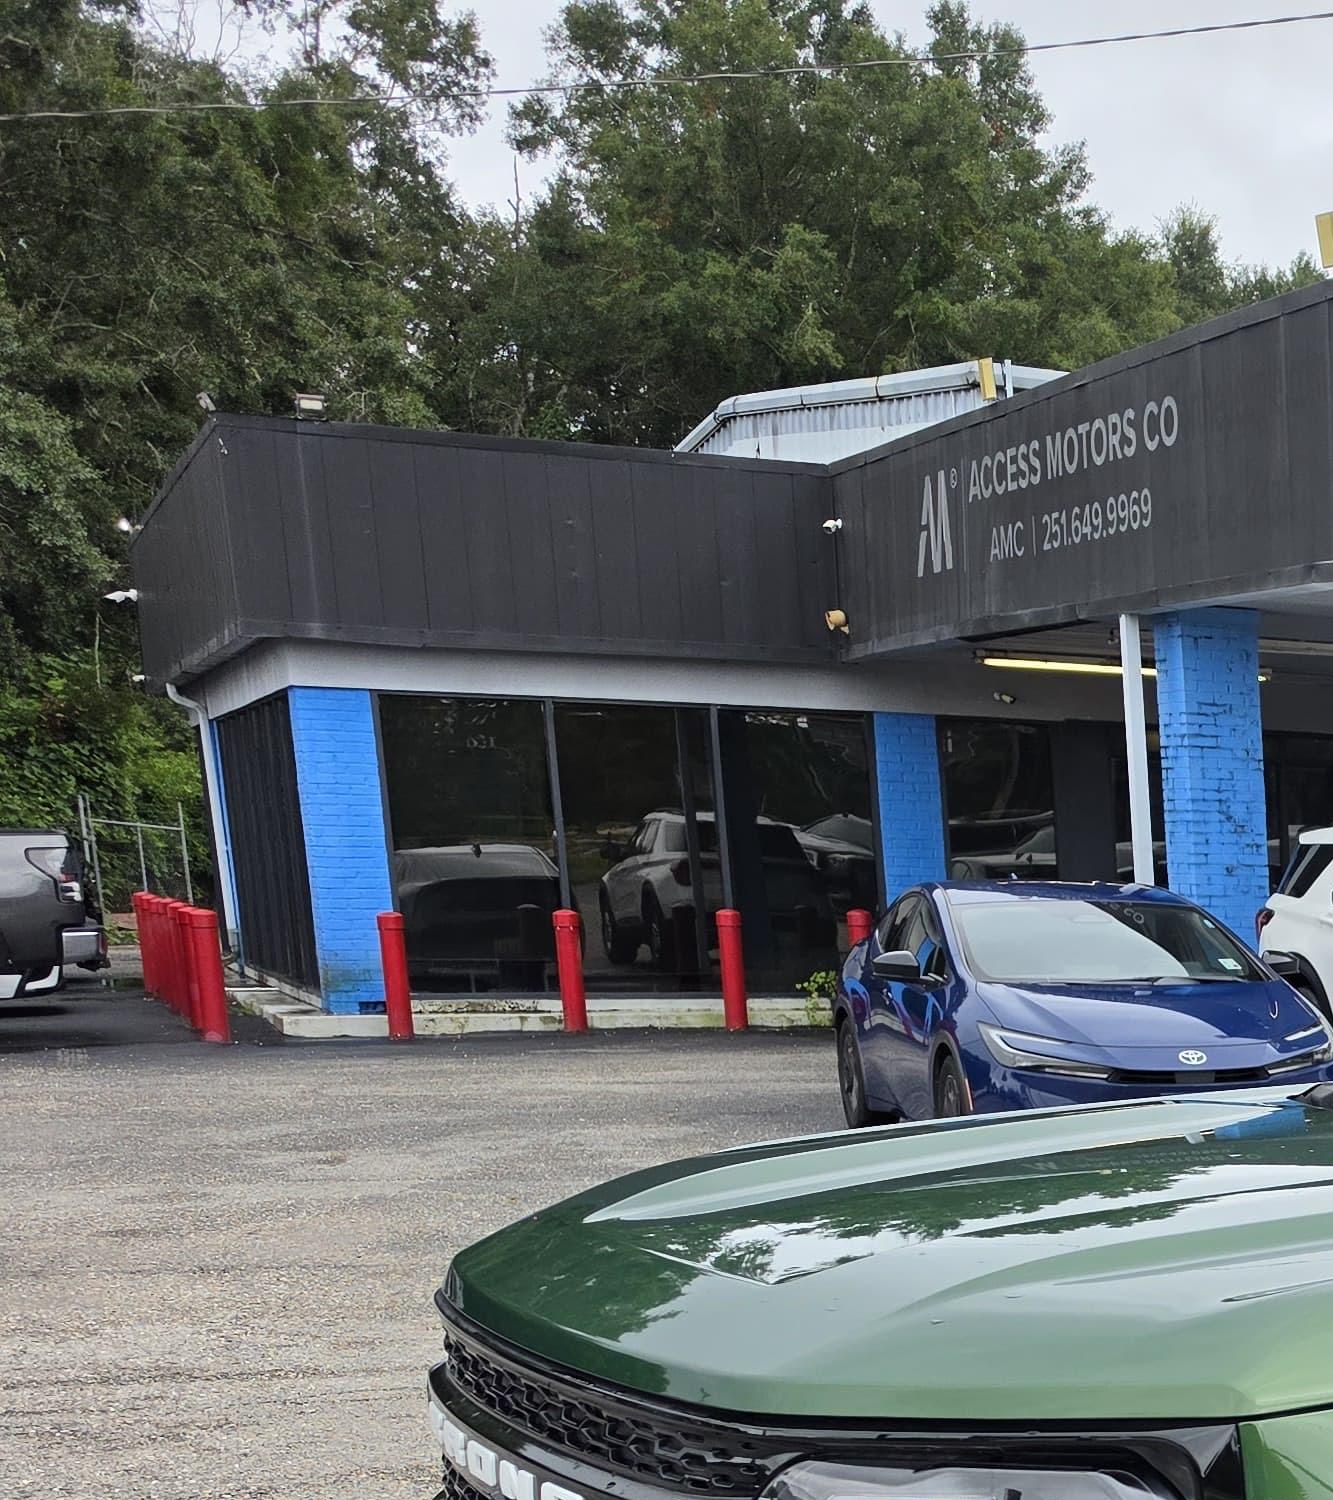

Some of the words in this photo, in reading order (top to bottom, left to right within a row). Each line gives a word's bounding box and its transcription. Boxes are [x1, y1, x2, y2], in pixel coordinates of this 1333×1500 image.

[968, 439, 1042, 503] ACCESS
[1045, 408, 1137, 480] MOTORS
[1142, 395, 1179, 452] CO
[989, 520, 1025, 562] AMC
[1042, 488, 1152, 551] 251.649.9969
